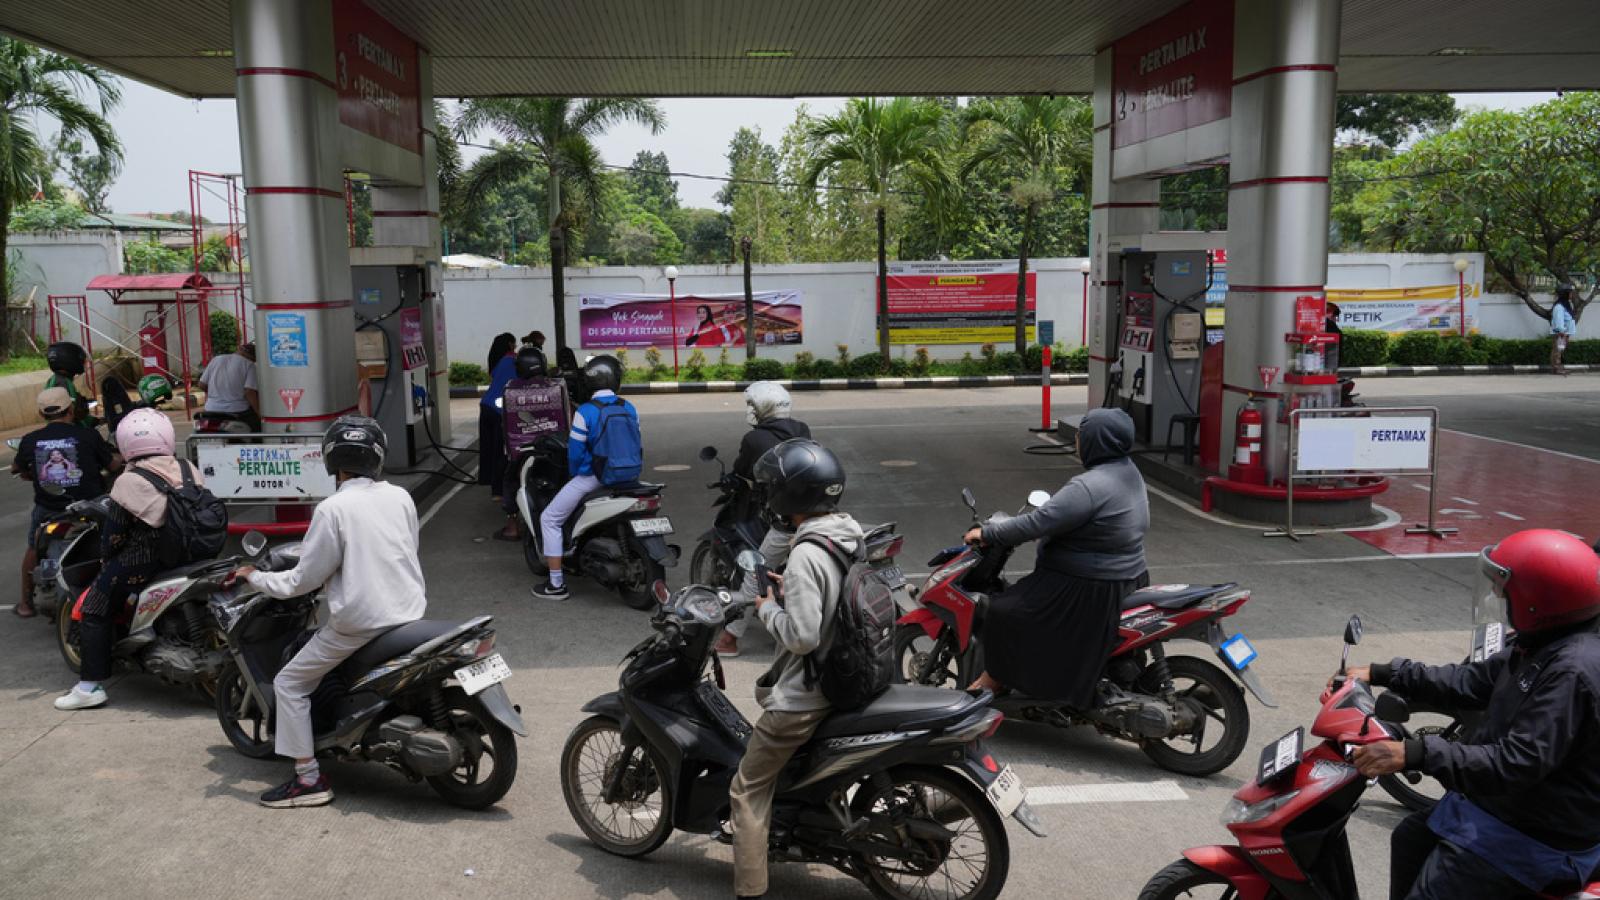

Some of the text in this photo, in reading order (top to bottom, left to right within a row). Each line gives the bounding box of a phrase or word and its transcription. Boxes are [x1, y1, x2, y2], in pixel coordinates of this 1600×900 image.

[357, 32, 407, 81] PERTAMAX
[1139, 26, 1207, 76] PERTAMAX
[339, 51, 348, 90] 3
[1343, 312, 1382, 323] PETIK
[588, 327, 598, 336] DI
[601, 327, 626, 336] SPBU
[1371, 430, 1427, 442] PERTAMAX
[238, 461, 301, 476] PERTALITE
[253, 480, 284, 488] MOTOR
[1249, 847, 1284, 857] HONDA
